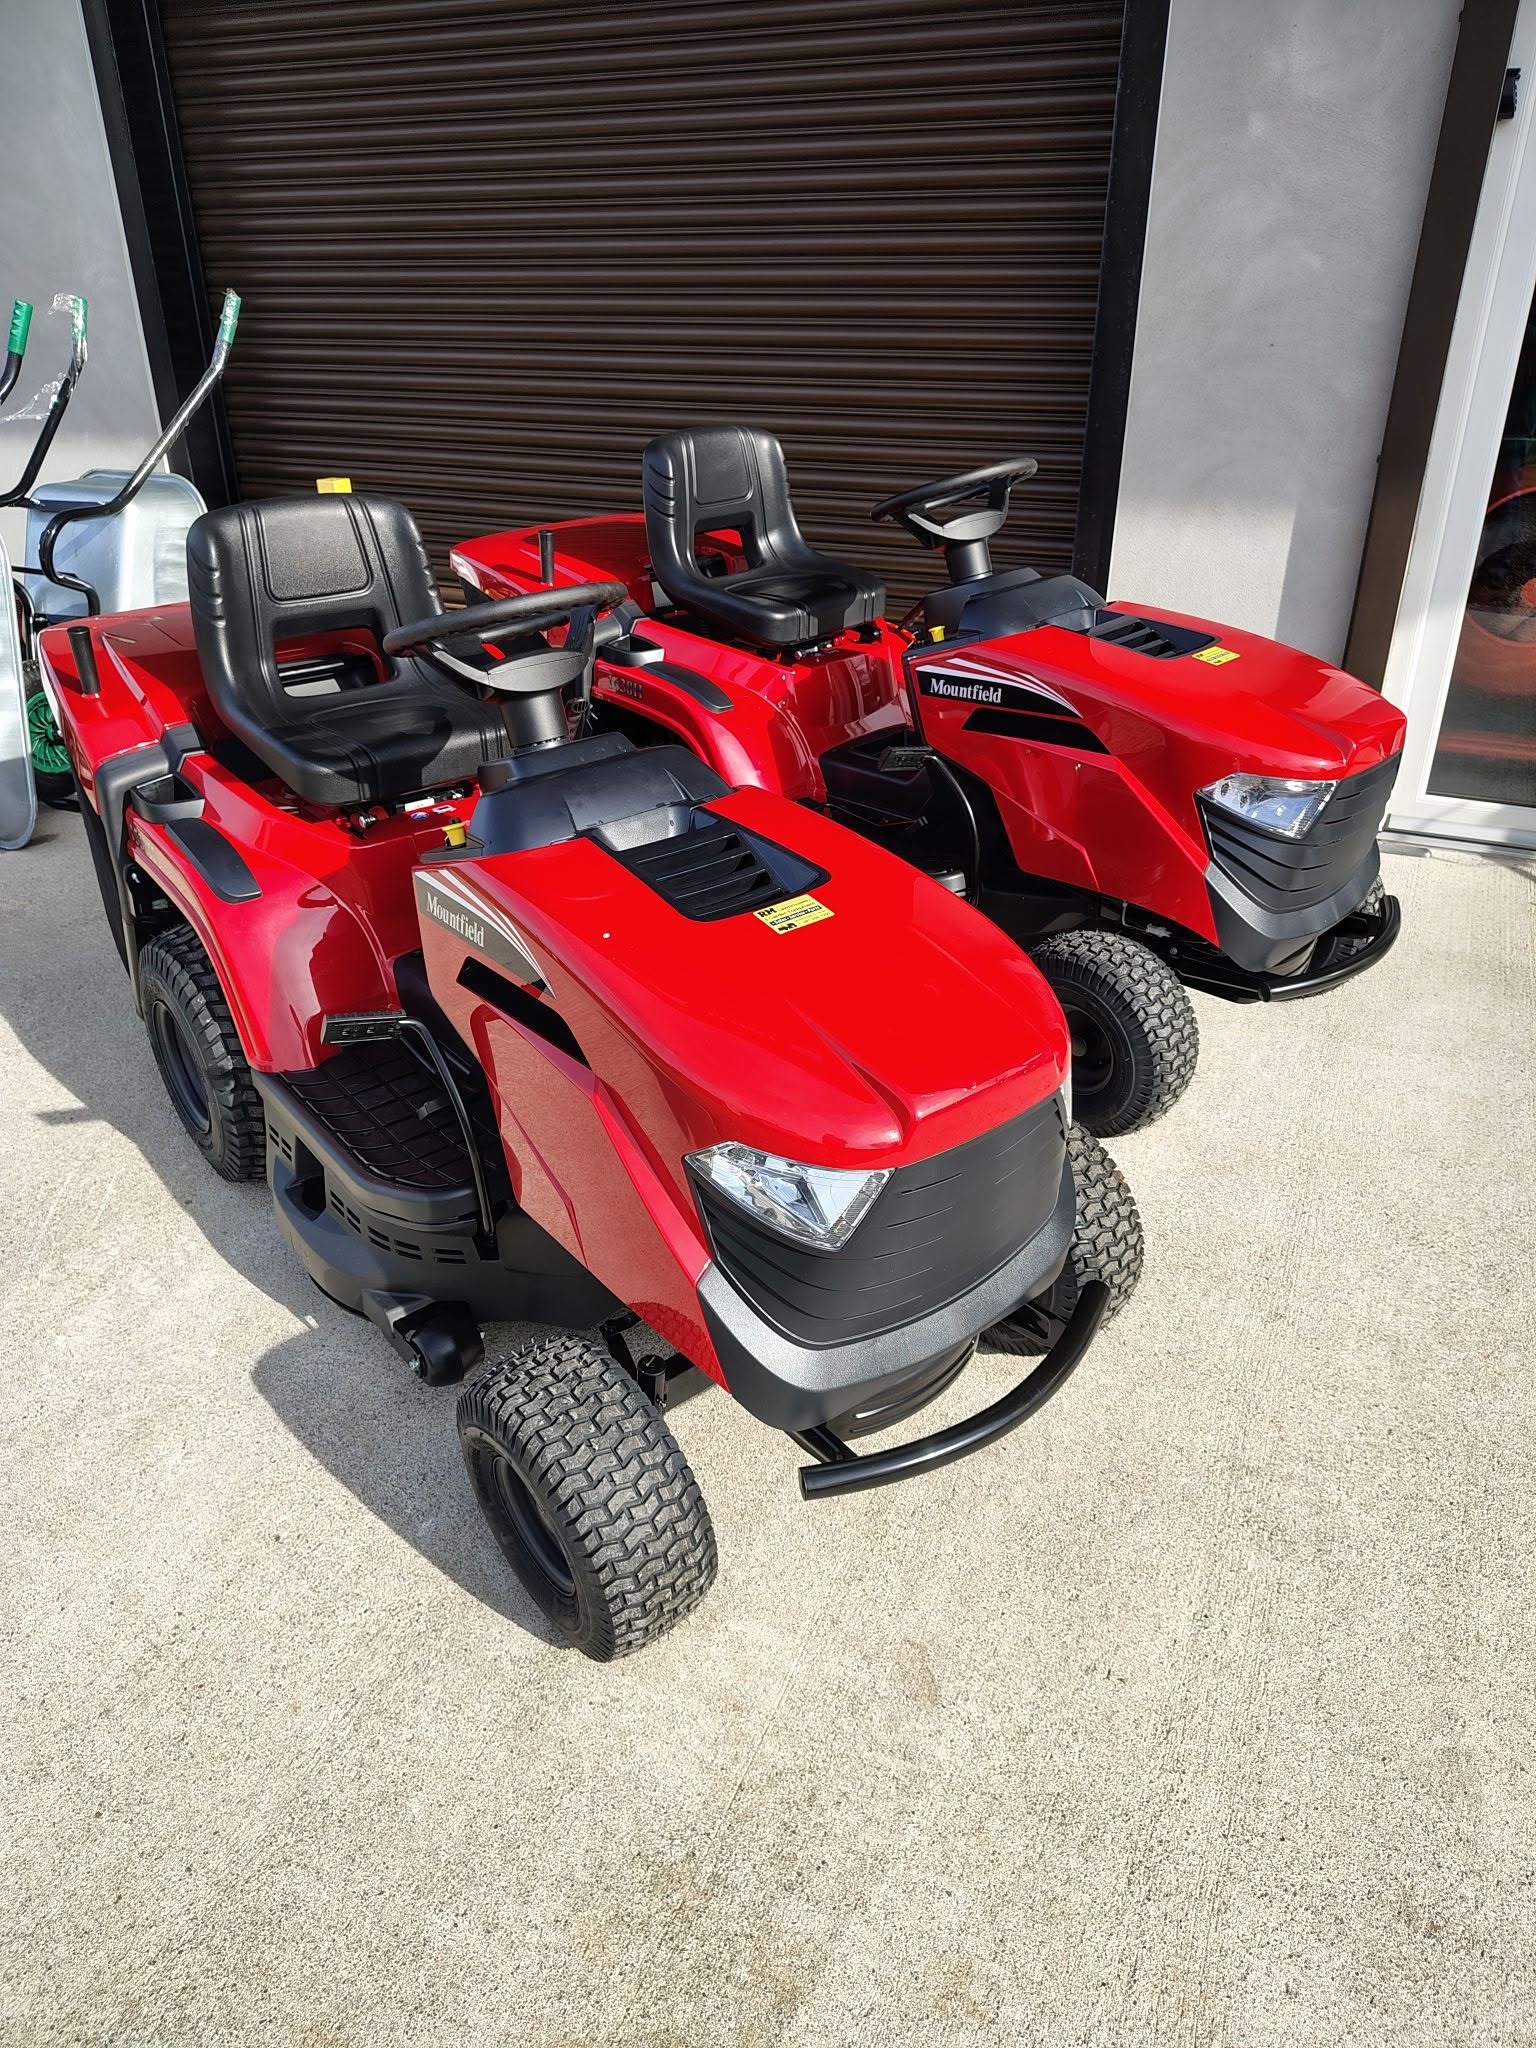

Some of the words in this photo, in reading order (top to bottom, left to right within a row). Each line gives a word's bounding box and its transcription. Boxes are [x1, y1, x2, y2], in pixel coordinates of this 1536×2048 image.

[929, 677, 1002, 703] Mountfield
[426, 891, 485, 948] Mountfield
[757, 907, 777, 918] RM
